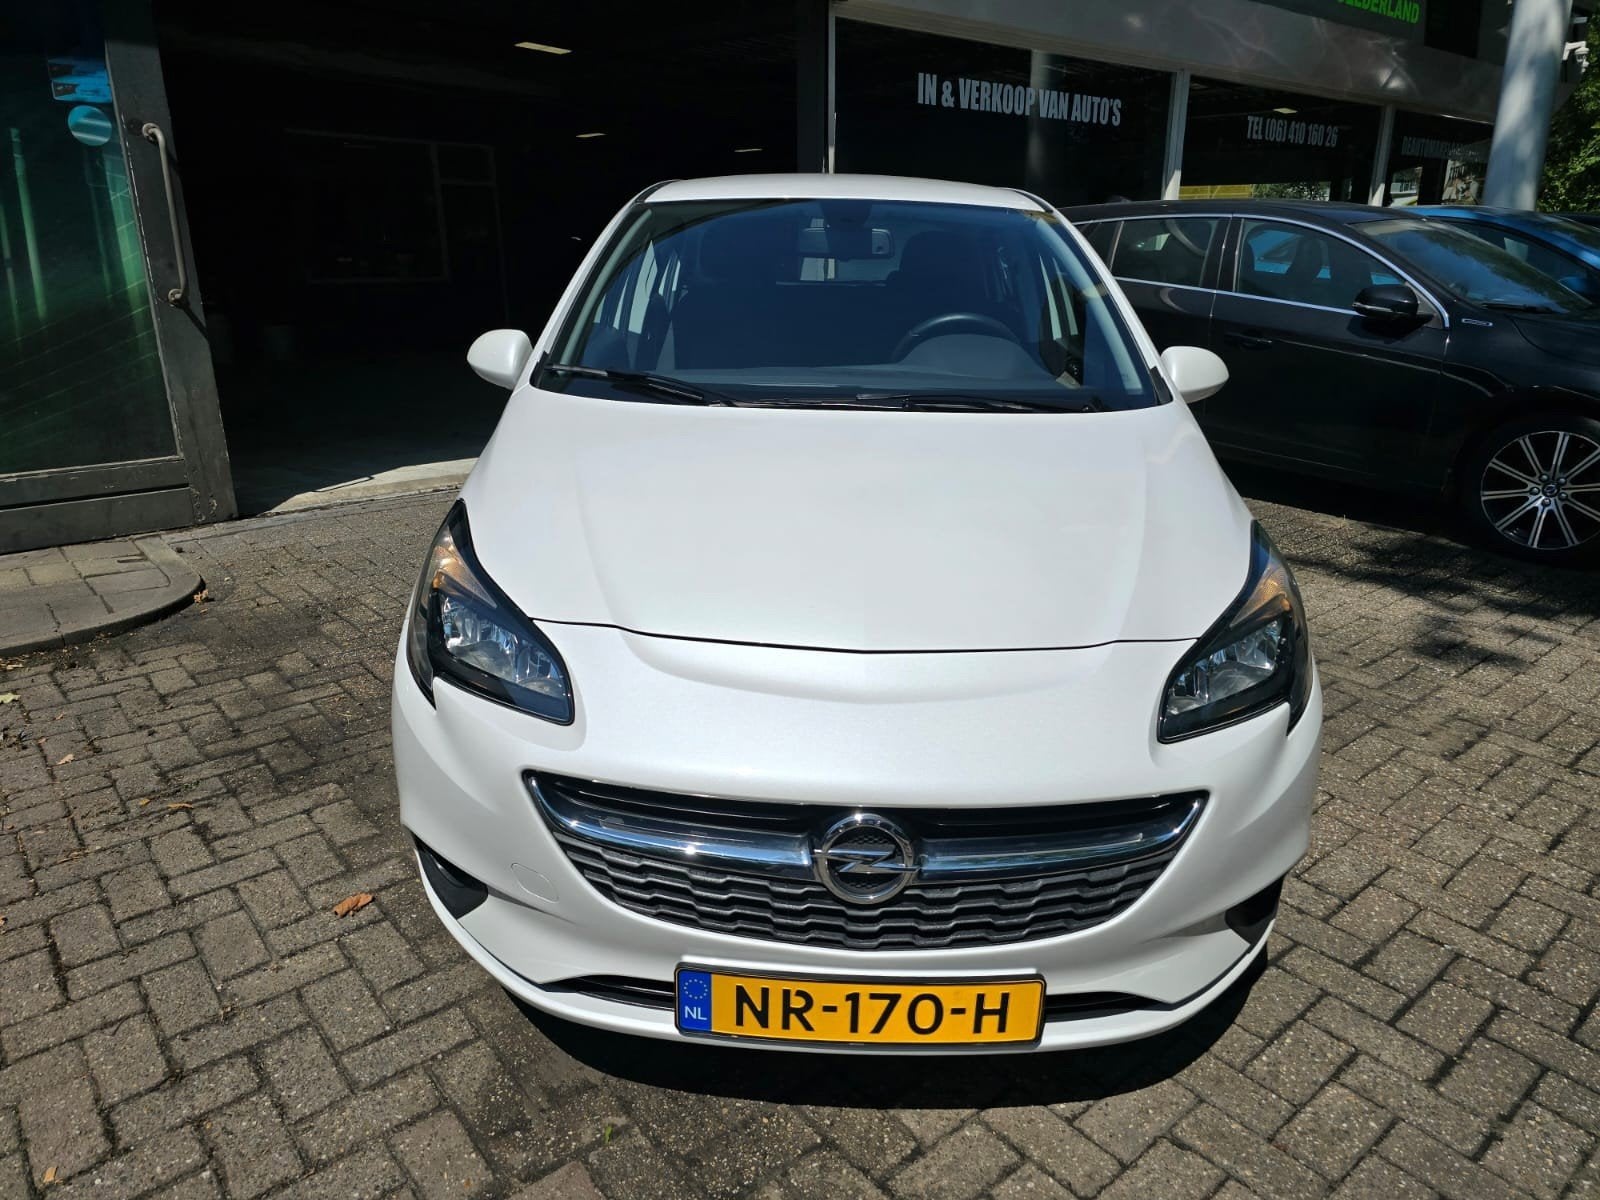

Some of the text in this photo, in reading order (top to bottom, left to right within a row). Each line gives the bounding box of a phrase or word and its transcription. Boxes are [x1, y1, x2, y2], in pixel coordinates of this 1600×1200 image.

[1337, 0, 1420, 24] ERLAND
[917, 72, 1122, 126] IN & VERKOOP VAN AUTO'S
[1247, 115, 1338, 148] TEL (06) 410 160 26
[684, 1005, 708, 1021] NL
[734, 984, 1011, 1036] NR-170-H
